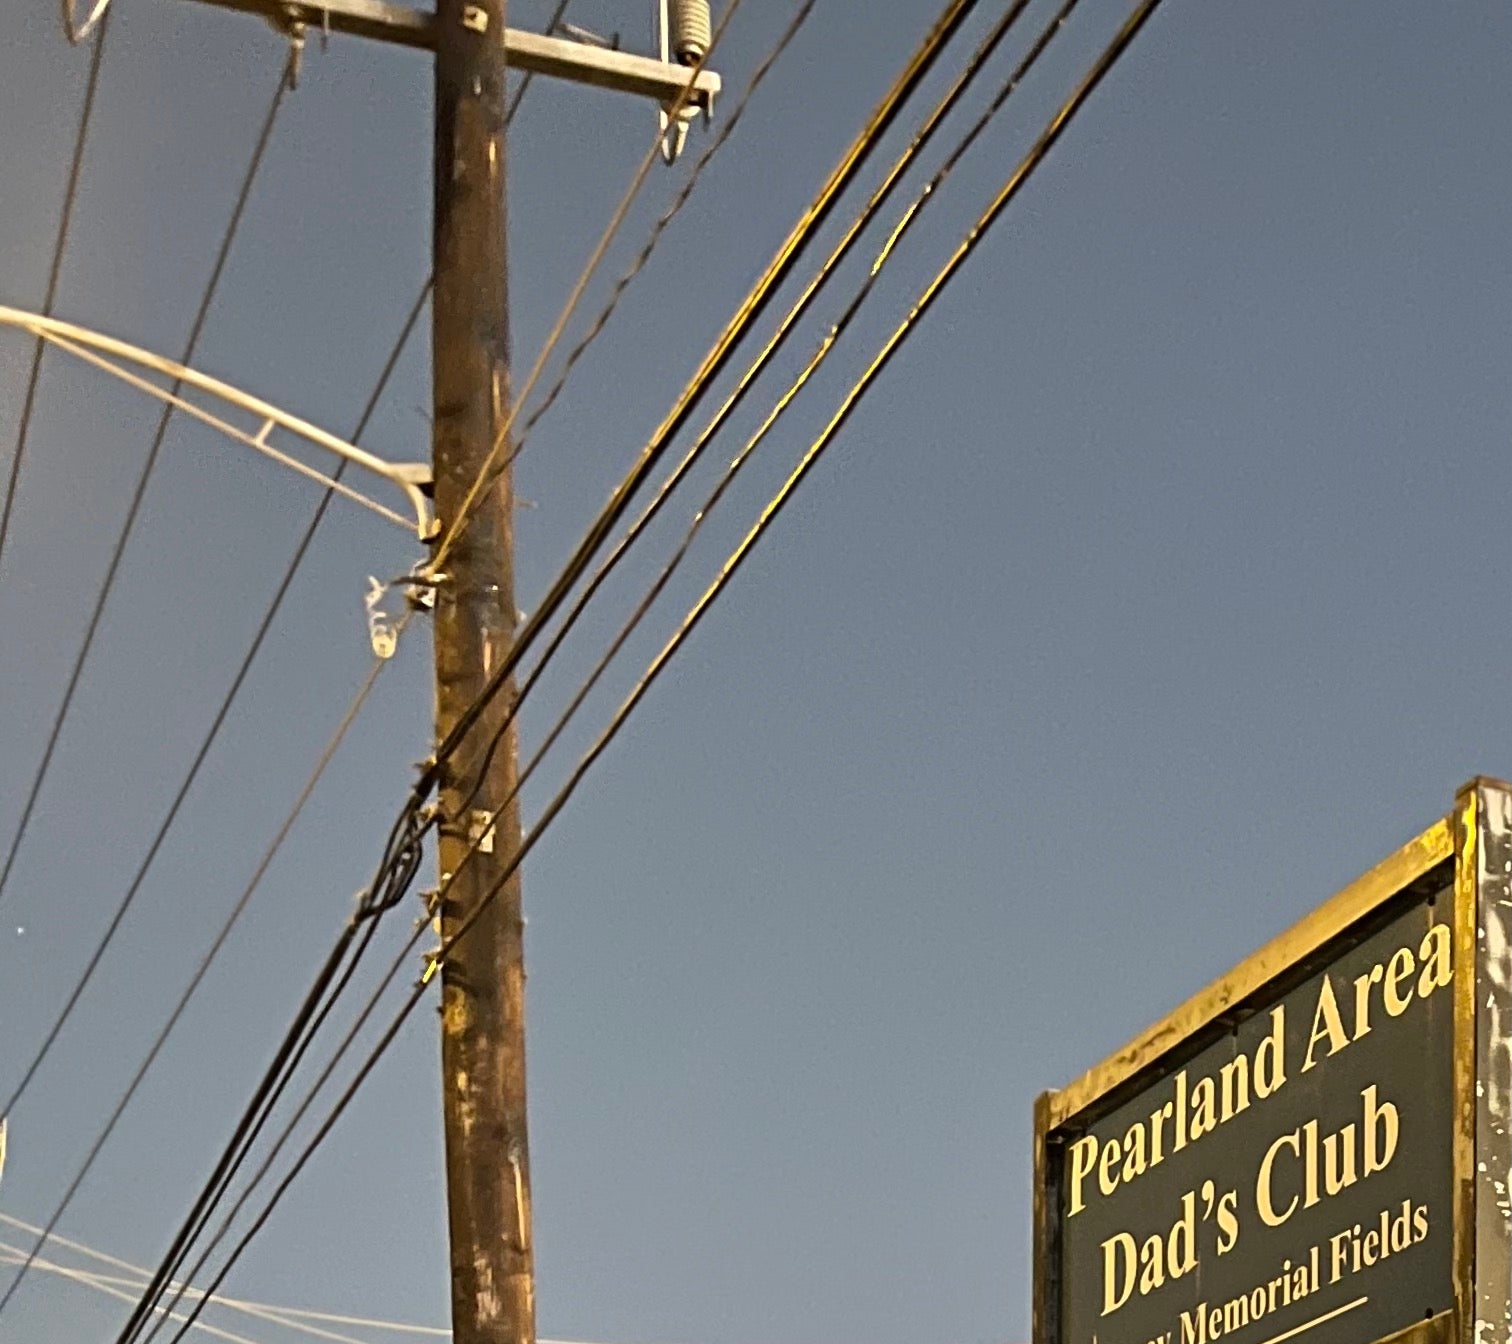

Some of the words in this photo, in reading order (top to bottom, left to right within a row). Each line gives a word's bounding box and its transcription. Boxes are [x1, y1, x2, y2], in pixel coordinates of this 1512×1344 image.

[1067, 1005, 1287, 1218] Pearland
[1300, 923, 1453, 1072] Area
[1101, 1180, 1238, 1317] Dad's
[1256, 1084, 1400, 1228] Club
[1330, 1199, 1429, 1285] Fields
